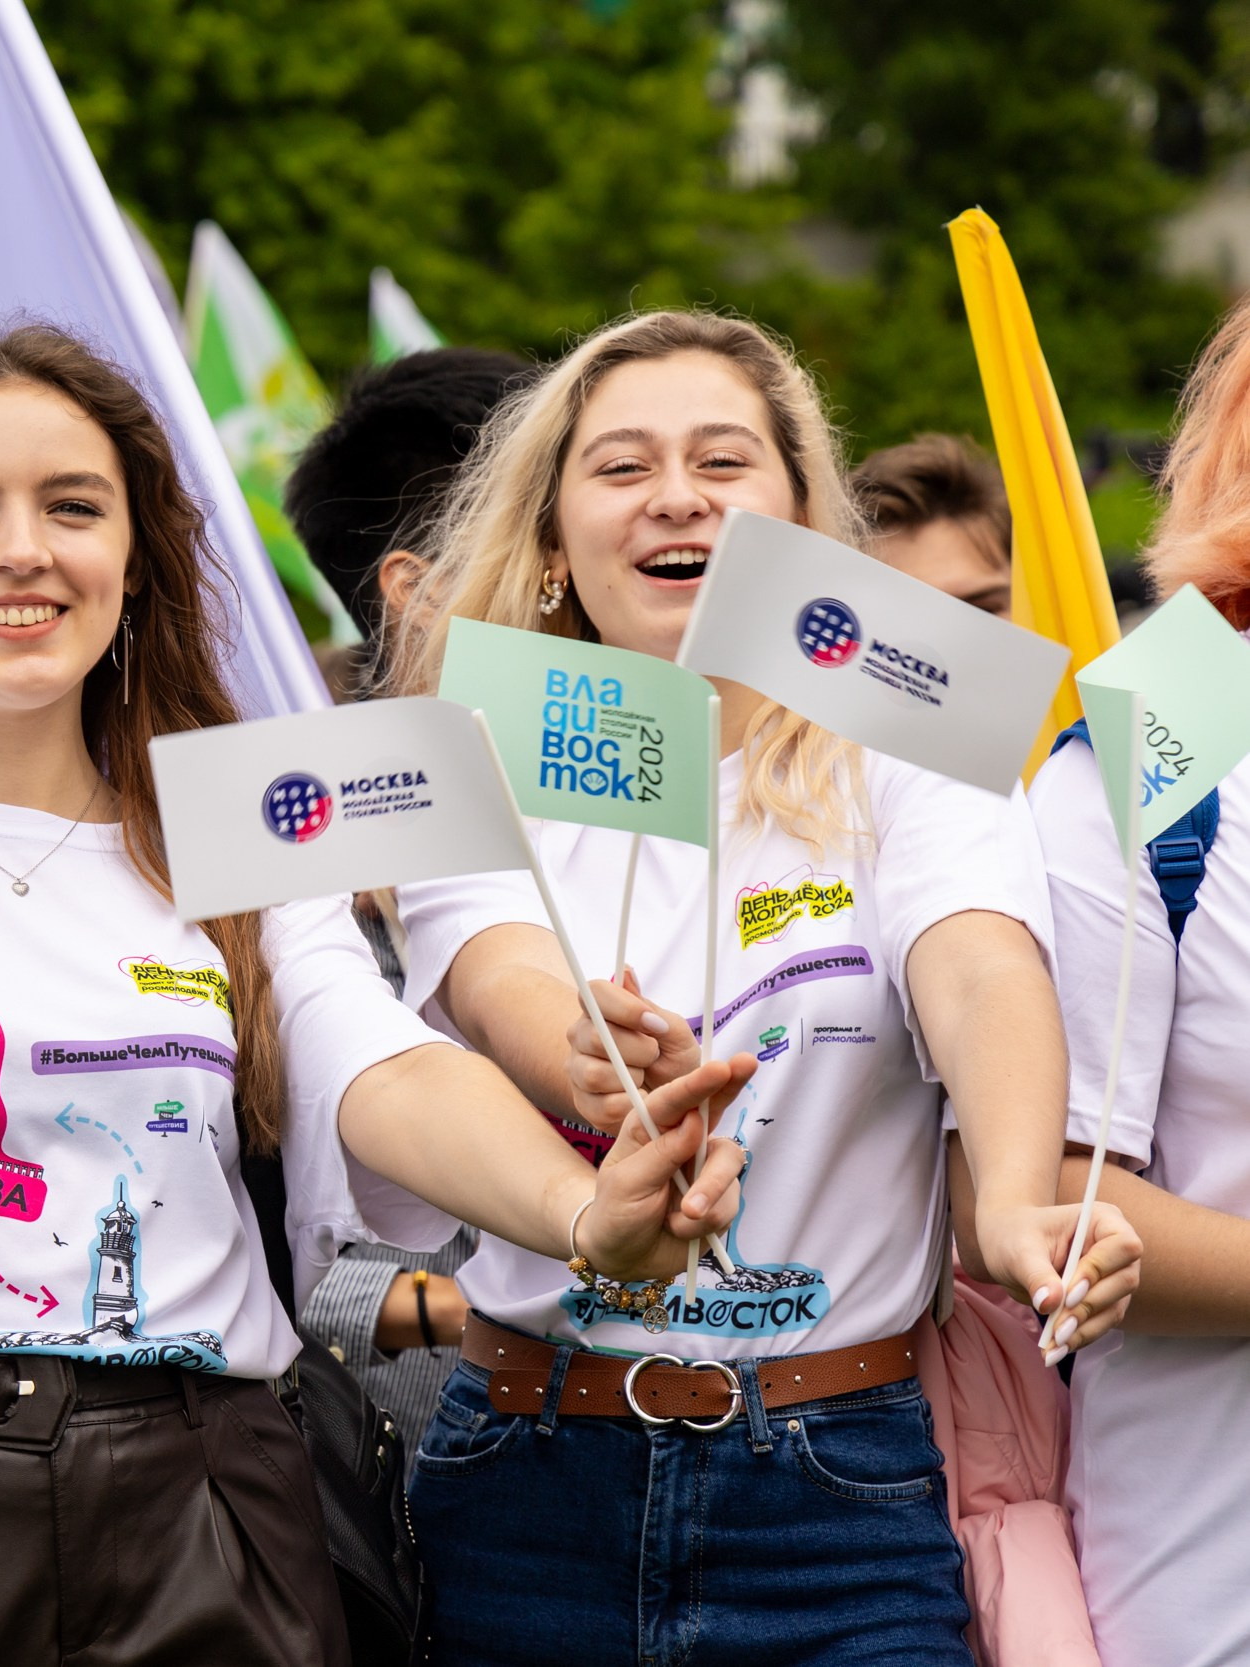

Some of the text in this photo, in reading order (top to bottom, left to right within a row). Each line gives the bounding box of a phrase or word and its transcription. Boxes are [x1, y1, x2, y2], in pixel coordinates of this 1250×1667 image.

[869, 638, 949, 688] МОСКВА
[637, 725, 664, 803] 2024
[340, 770, 428, 797] МОСКВА
[741, 892, 789, 917] ДЕНЬ
[743, 884, 843, 930] МОЛОДЁЖИ
[812, 891, 854, 917] 2024
